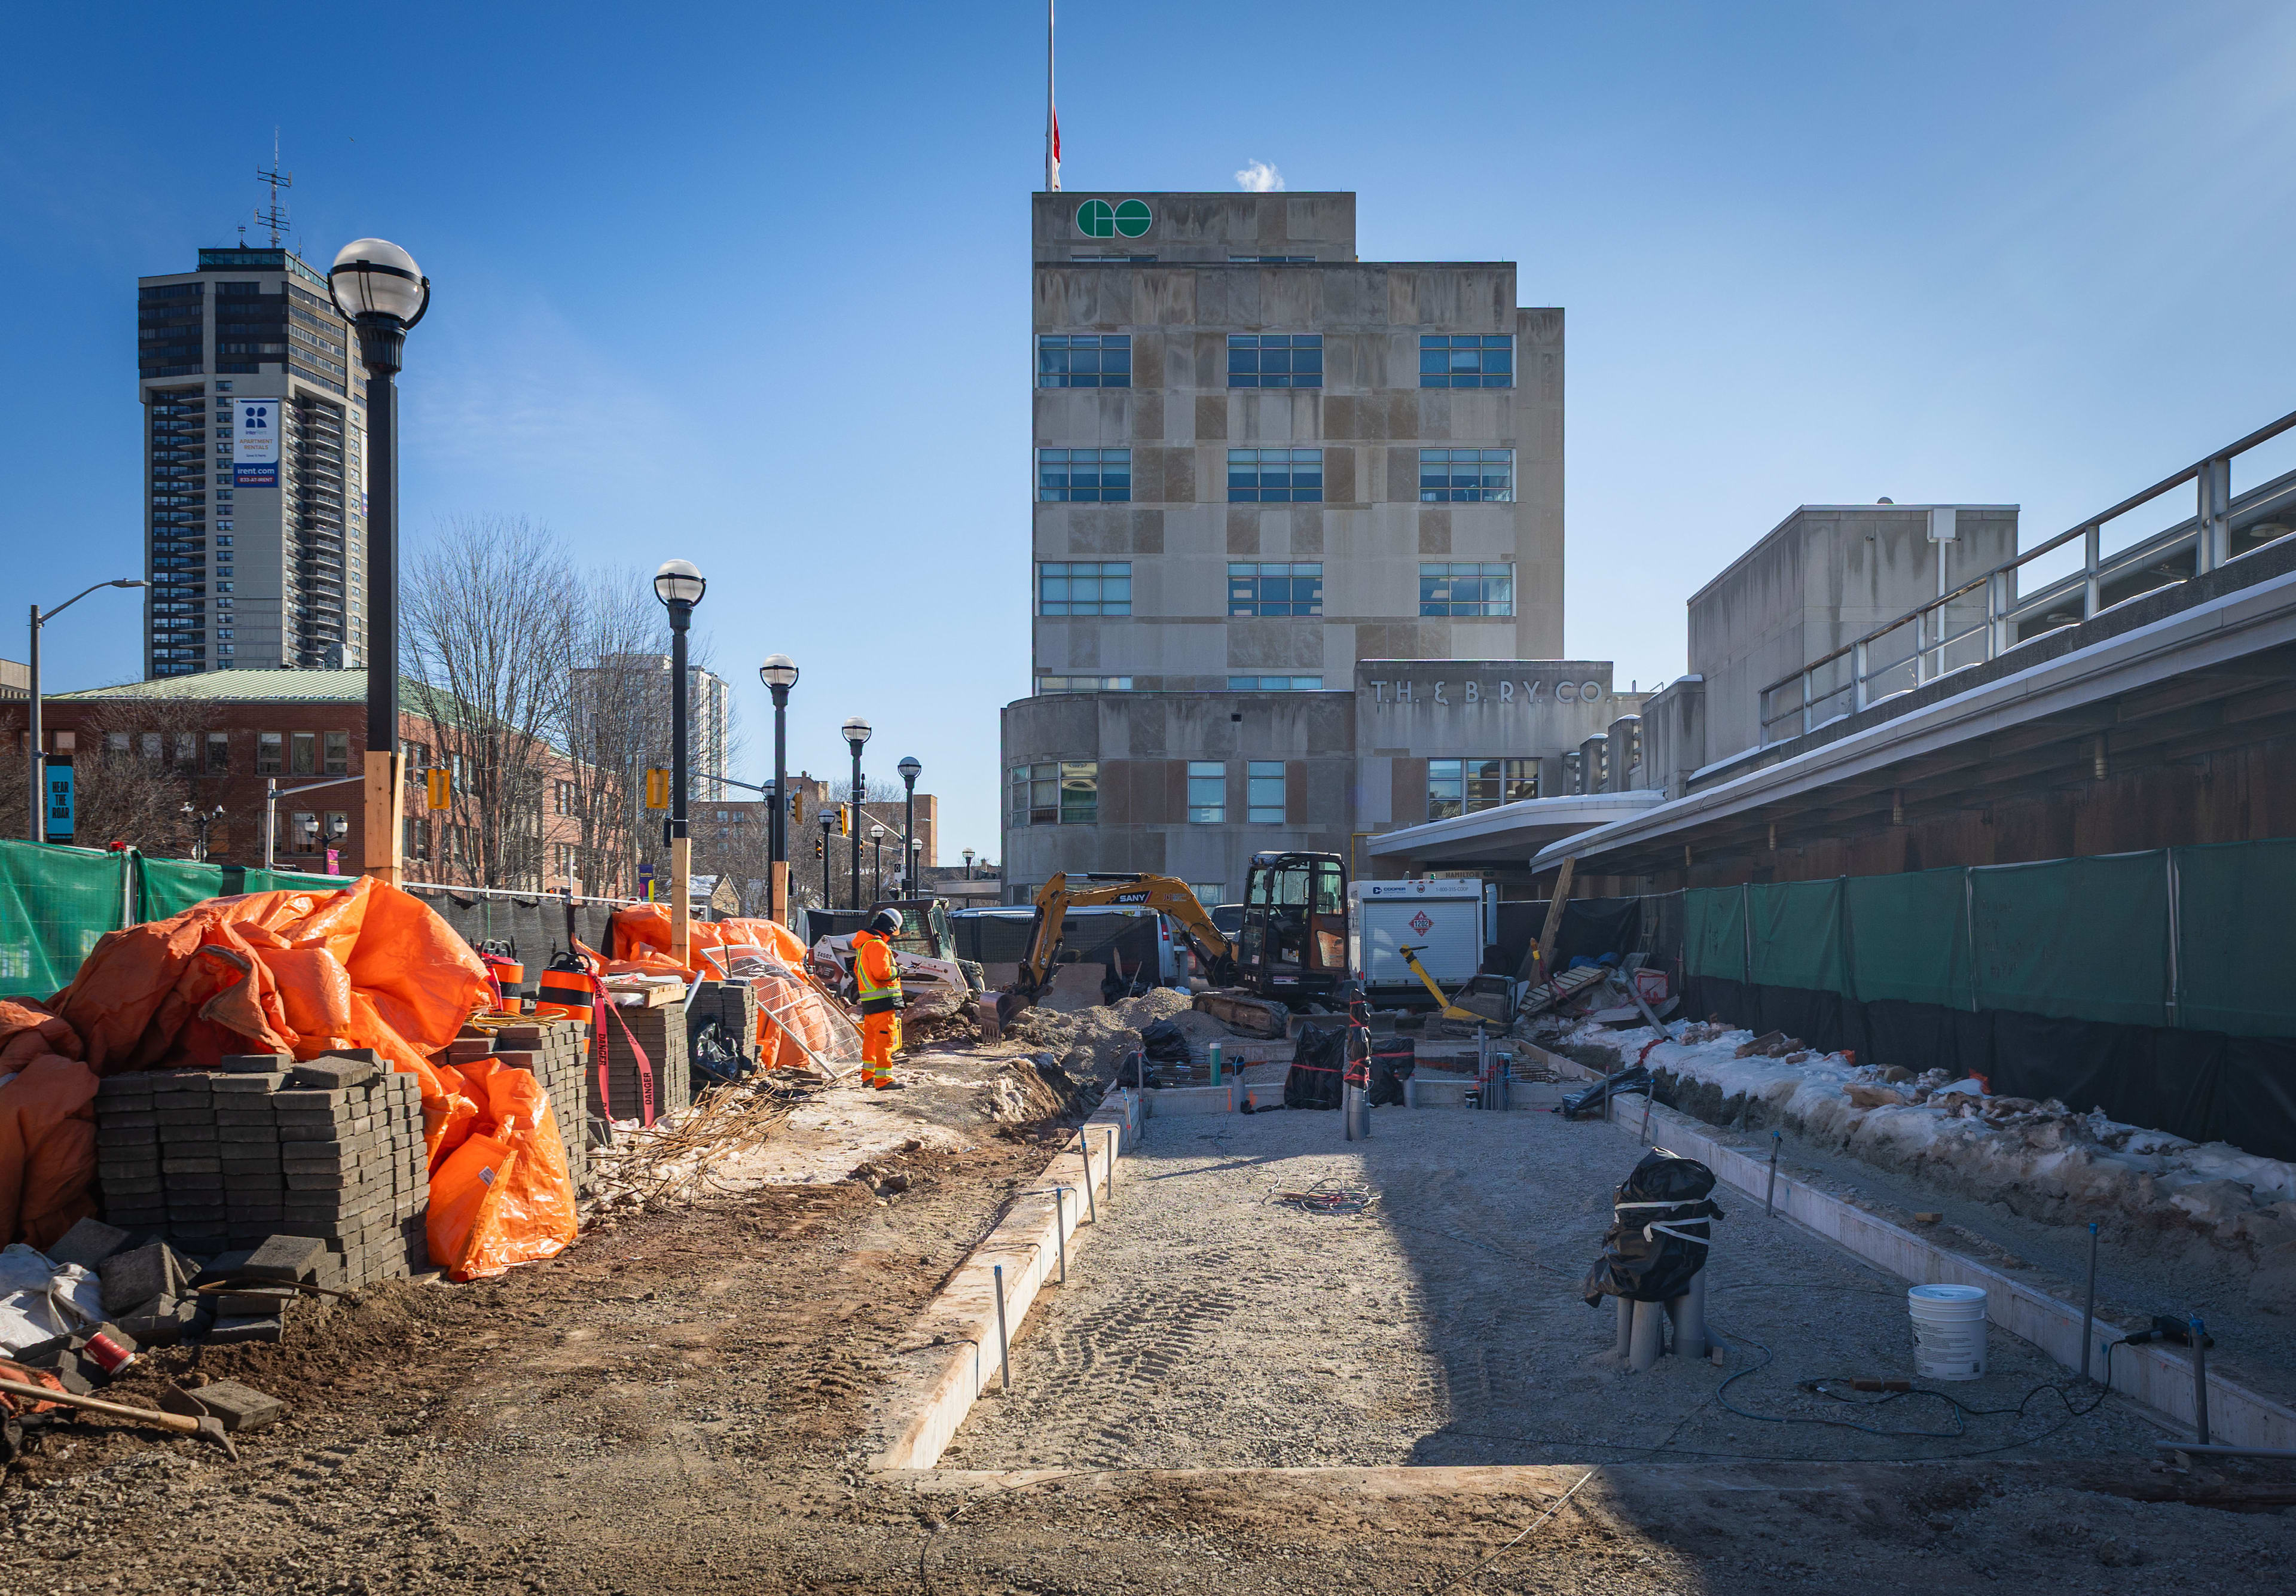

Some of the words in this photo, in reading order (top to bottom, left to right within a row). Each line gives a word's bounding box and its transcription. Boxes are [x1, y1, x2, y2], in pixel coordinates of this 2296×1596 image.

[1076, 199, 1153, 238] GO
[1555, 680, 1611, 703] CO.
[52, 781, 69, 793] HEAR
[55, 794, 67, 805] THE
[52, 807, 70, 819] ROAR
[598, 1033, 607, 1066] DANGER
[644, 1072, 654, 1105] DANGER
